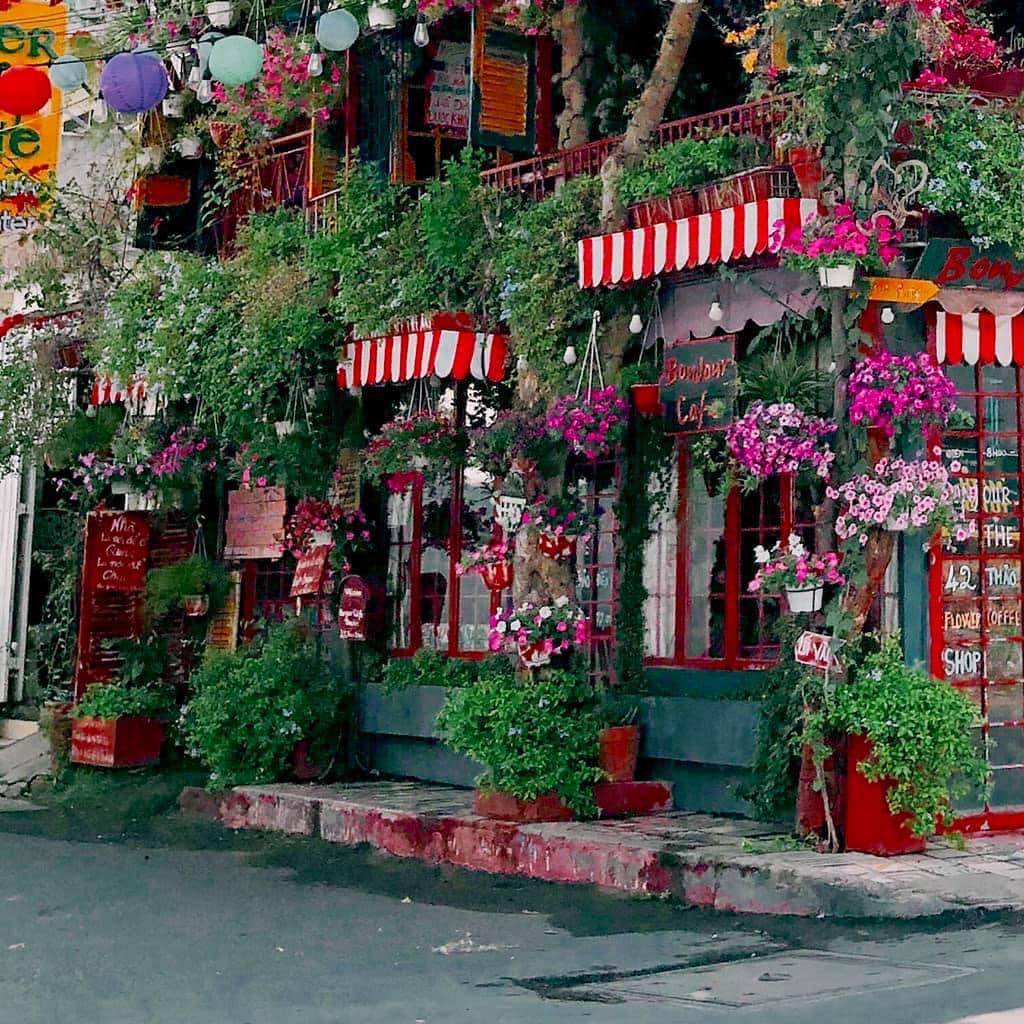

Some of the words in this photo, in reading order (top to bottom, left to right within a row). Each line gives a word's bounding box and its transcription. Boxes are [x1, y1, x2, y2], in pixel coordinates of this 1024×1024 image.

[985, 524, 1014, 547] THE
[944, 564, 976, 591] 42
[944, 647, 981, 676] SHOP
